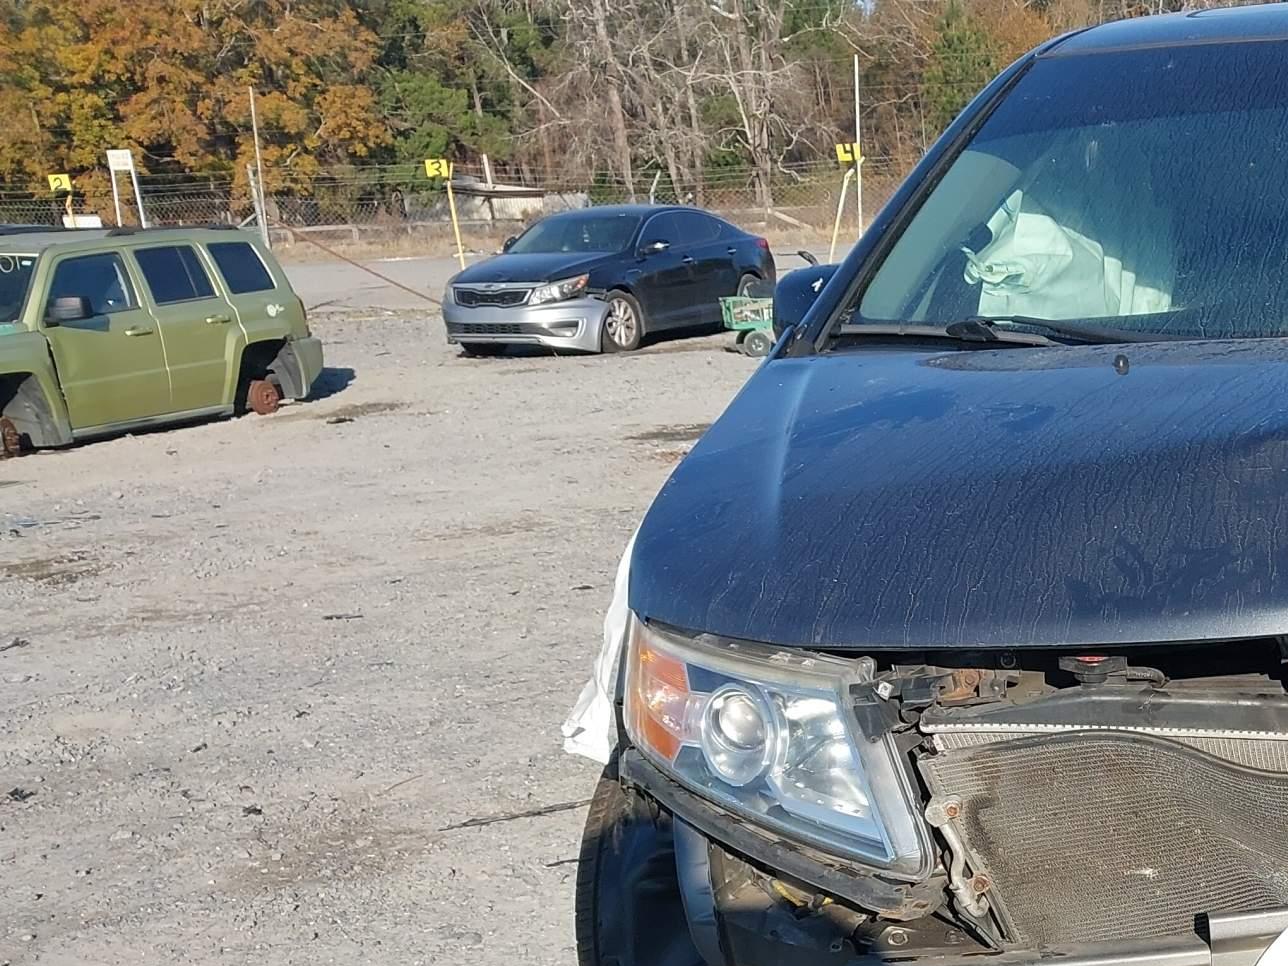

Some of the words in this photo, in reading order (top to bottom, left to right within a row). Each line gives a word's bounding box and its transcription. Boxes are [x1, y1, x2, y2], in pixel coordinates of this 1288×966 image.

[842, 143, 856, 161] 4
[430, 160, 443, 177] 3
[53, 177, 67, 192] 2
